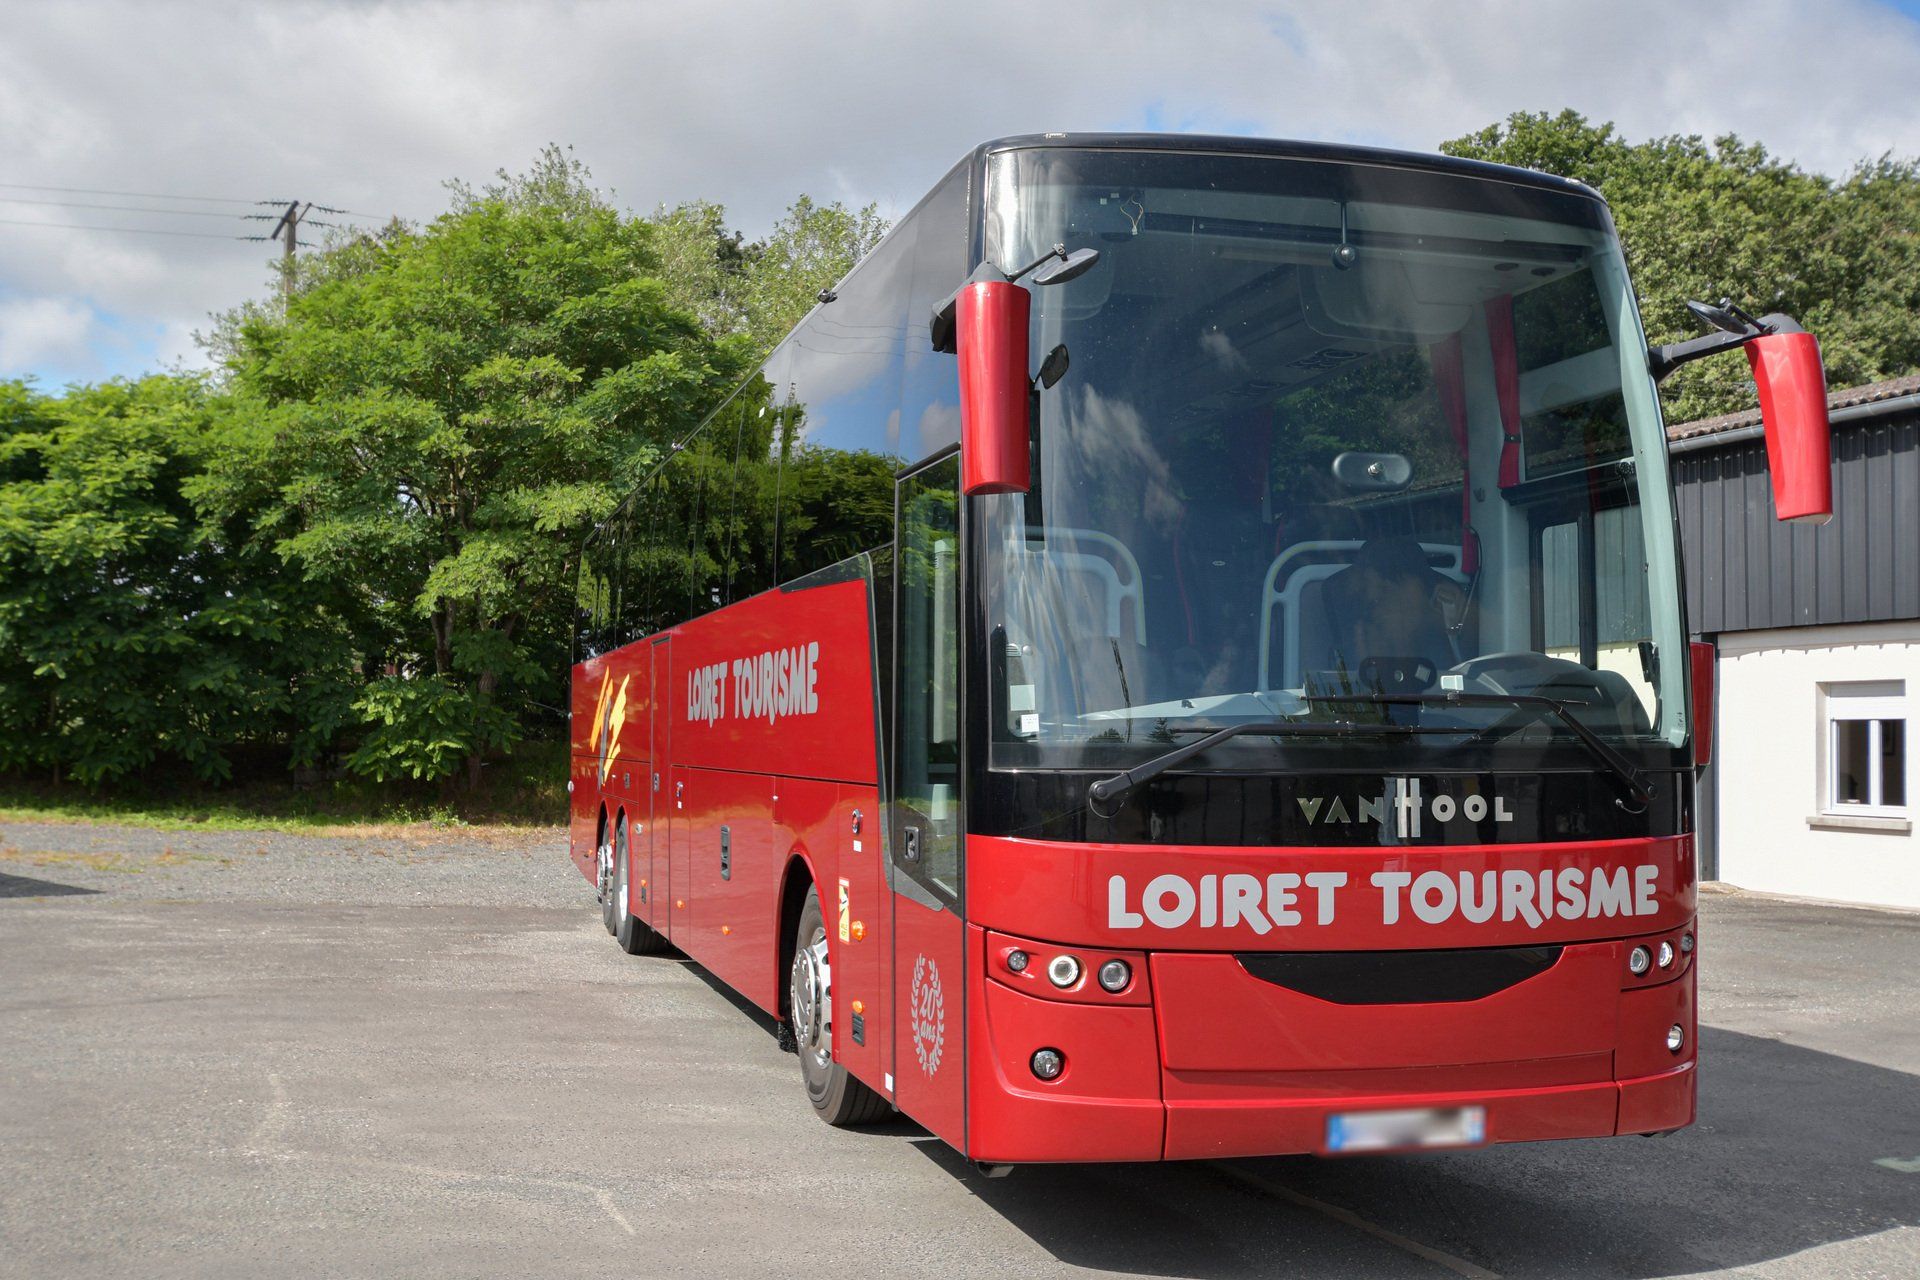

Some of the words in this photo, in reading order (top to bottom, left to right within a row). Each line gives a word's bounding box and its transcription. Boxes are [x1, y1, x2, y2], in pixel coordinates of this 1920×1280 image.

[688, 661, 728, 728] LOIRET
[733, 641, 819, 726] TOURISME
[1108, 872, 1347, 935] LOIRET
[1370, 864, 1660, 929] TOURISME
[919, 983, 937, 1021] 20
[920, 1020, 936, 1043] ans
